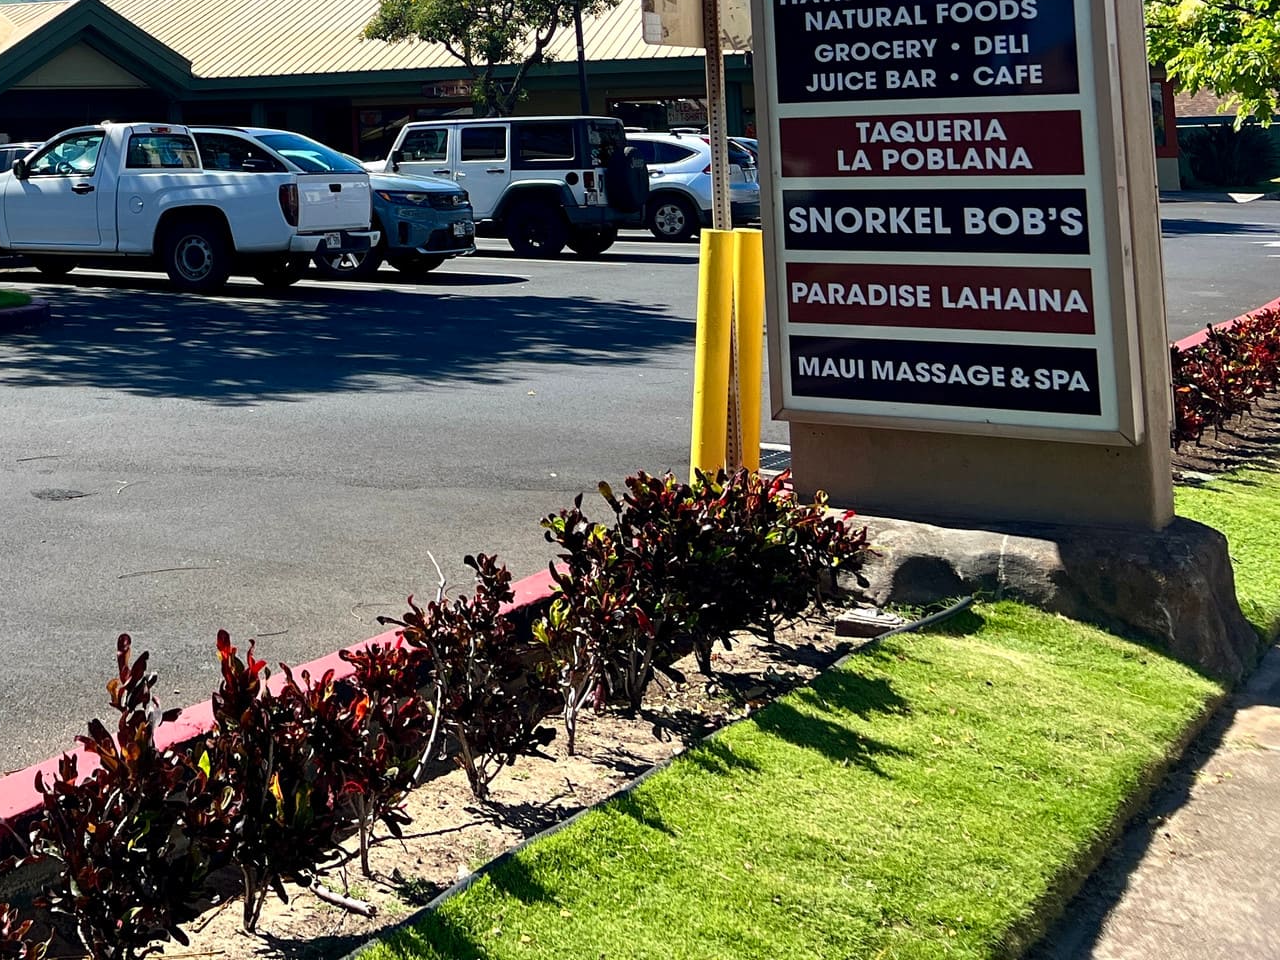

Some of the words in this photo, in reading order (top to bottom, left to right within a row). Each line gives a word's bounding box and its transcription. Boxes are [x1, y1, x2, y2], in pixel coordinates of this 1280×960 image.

[805, 5, 927, 31] NATURAL
[815, 39, 937, 62] GROCERY
[975, 34, 1029, 55] DELI
[806, 72, 876, 92] JUICE
[886, 69, 936, 88] BAR
[974, 65, 1042, 85] CAFE
[856, 119, 1007, 143] TAQUERIA
[838, 150, 872, 170] LA
[883, 147, 1032, 170] POBLANA
[789, 207, 951, 234] SNORKEL
[964, 207, 1082, 235] BOB'S
[792, 283, 930, 307] PARADISE
[942, 286, 1088, 312] LAHAINA
[799, 357, 864, 378] MAUI
[872, 360, 1005, 386] MASSAGE
[1011, 368, 1029, 388] &
[1035, 369, 1090, 391] SPA
